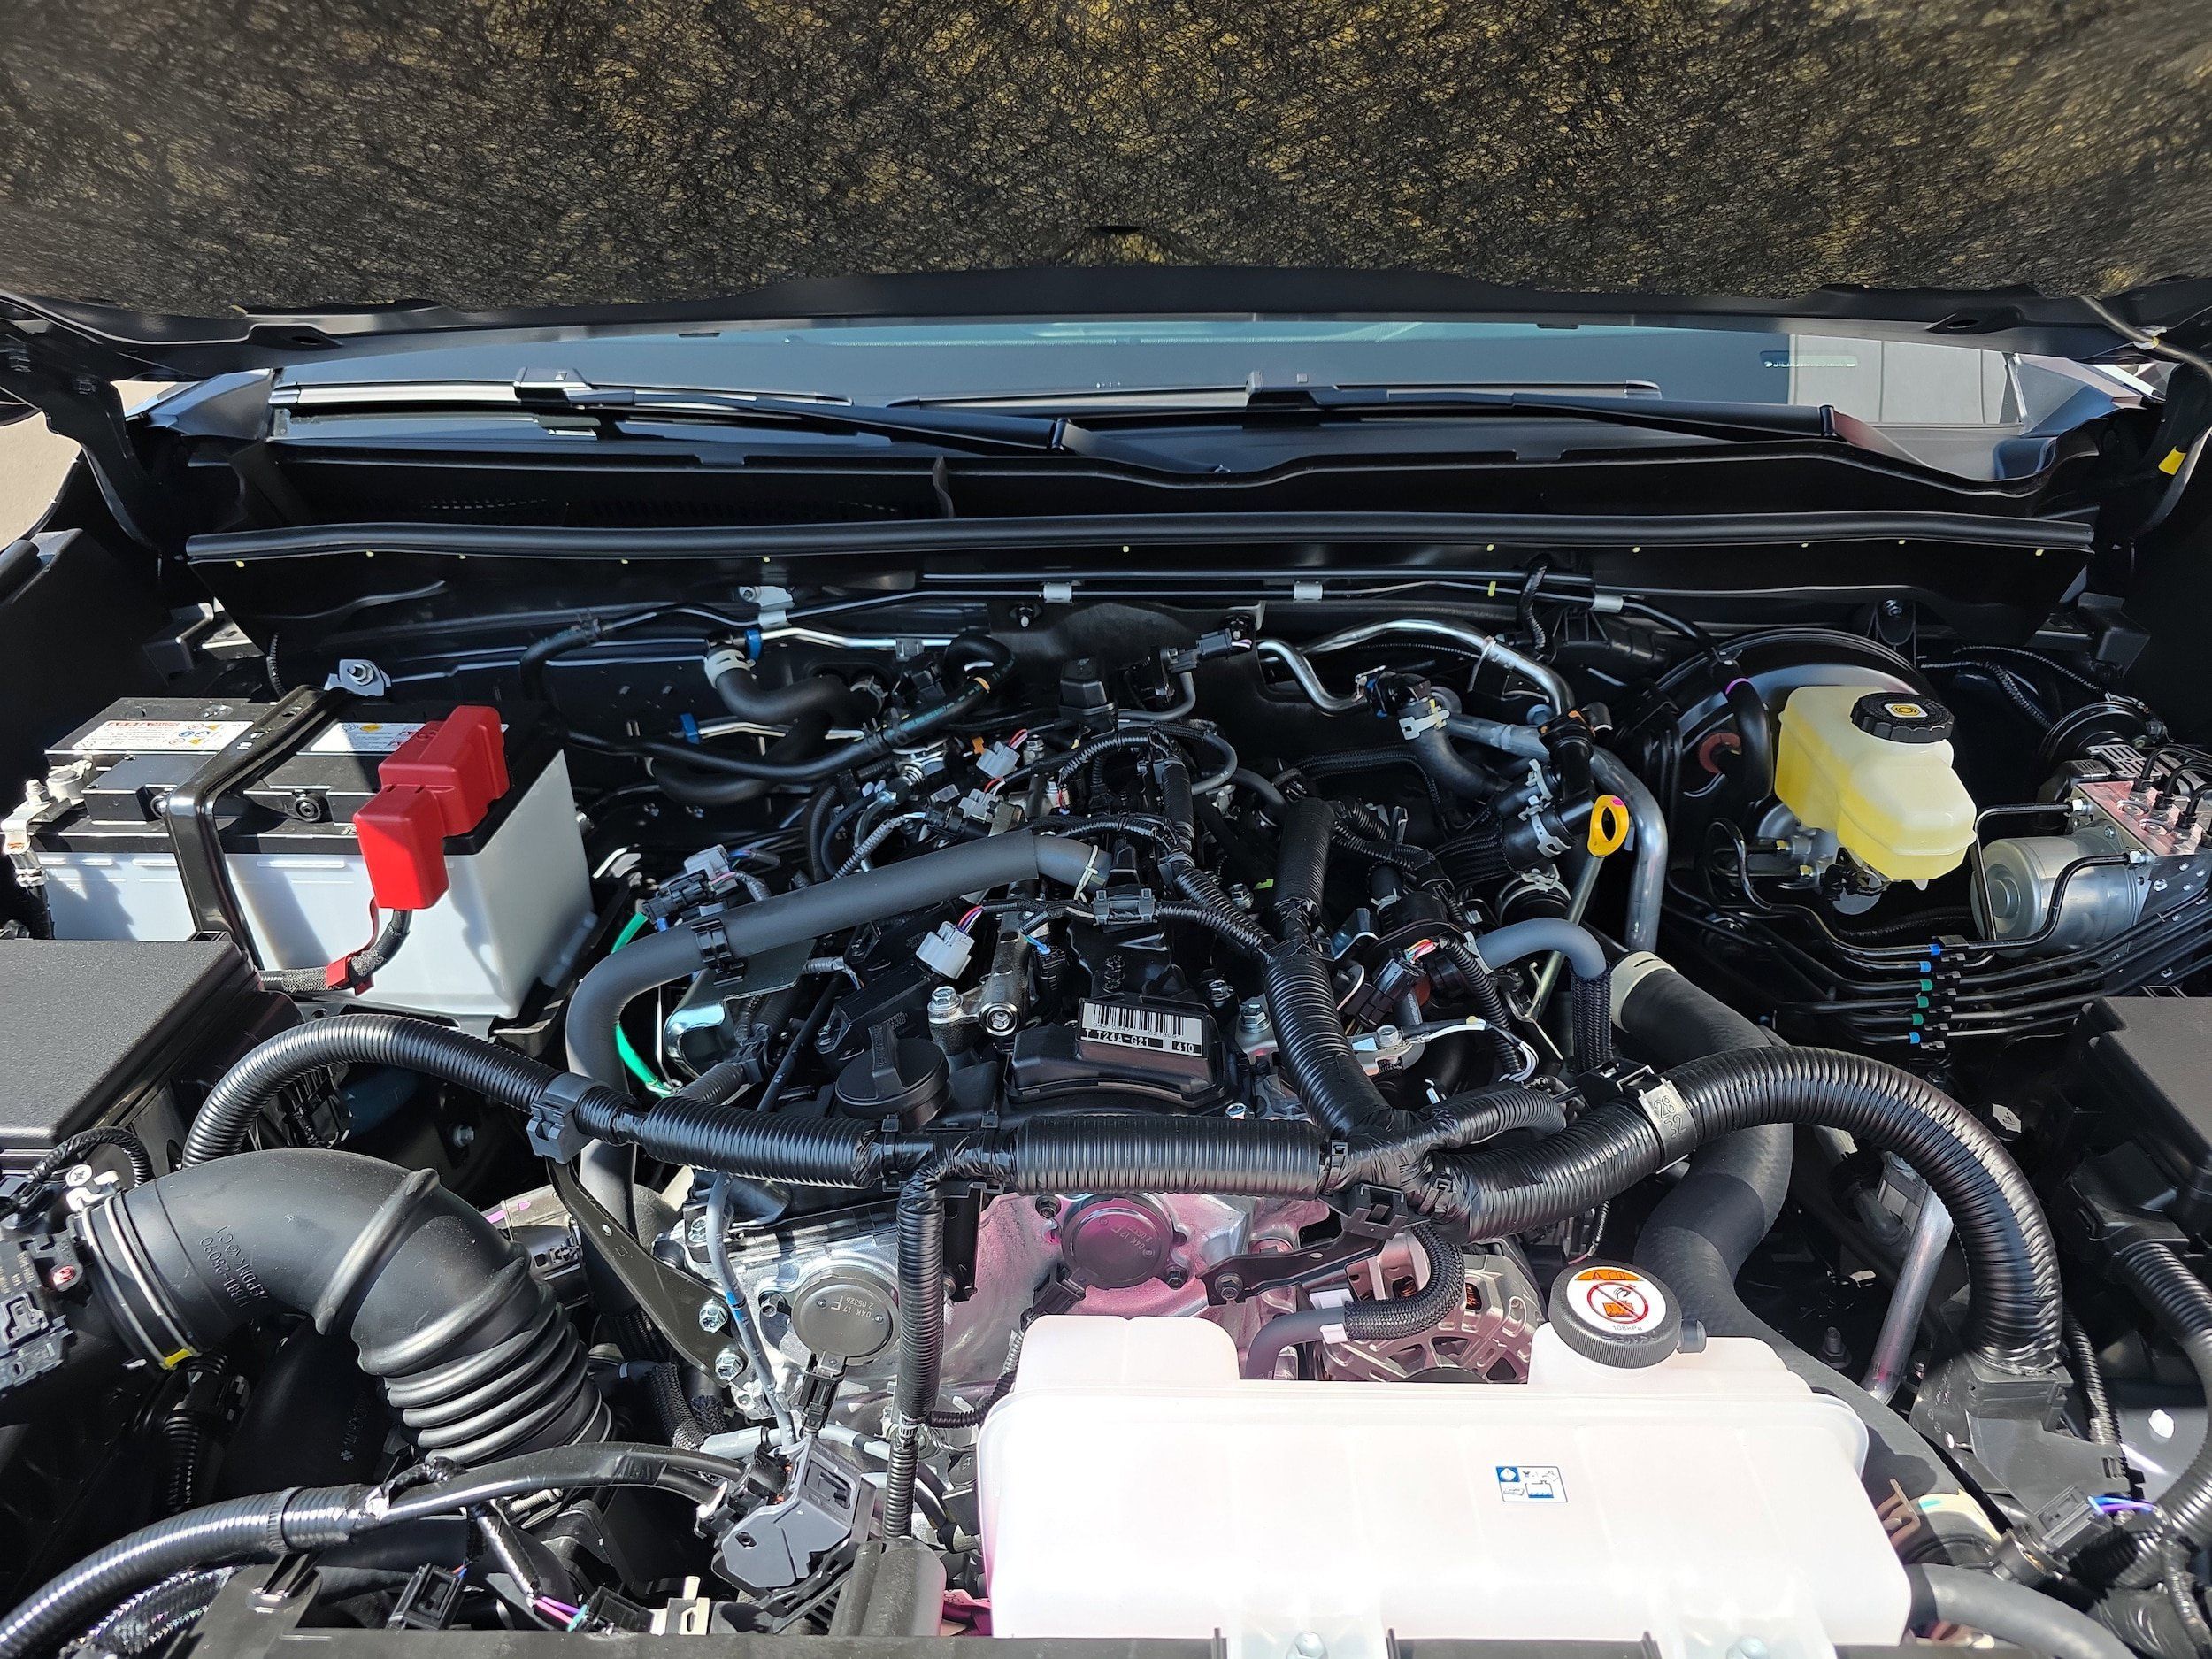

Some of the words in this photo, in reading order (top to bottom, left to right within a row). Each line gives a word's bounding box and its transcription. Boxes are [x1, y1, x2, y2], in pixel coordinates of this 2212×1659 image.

[1085, 1028, 1092, 1039] T
[1097, 1031, 1149, 1047] T24A-G21
[1176, 1043, 1194, 1054] 410
[1653, 1095, 1676, 1119] 28
[1663, 1113, 1687, 1139] 32
[831, 1295, 843, 1311] F
